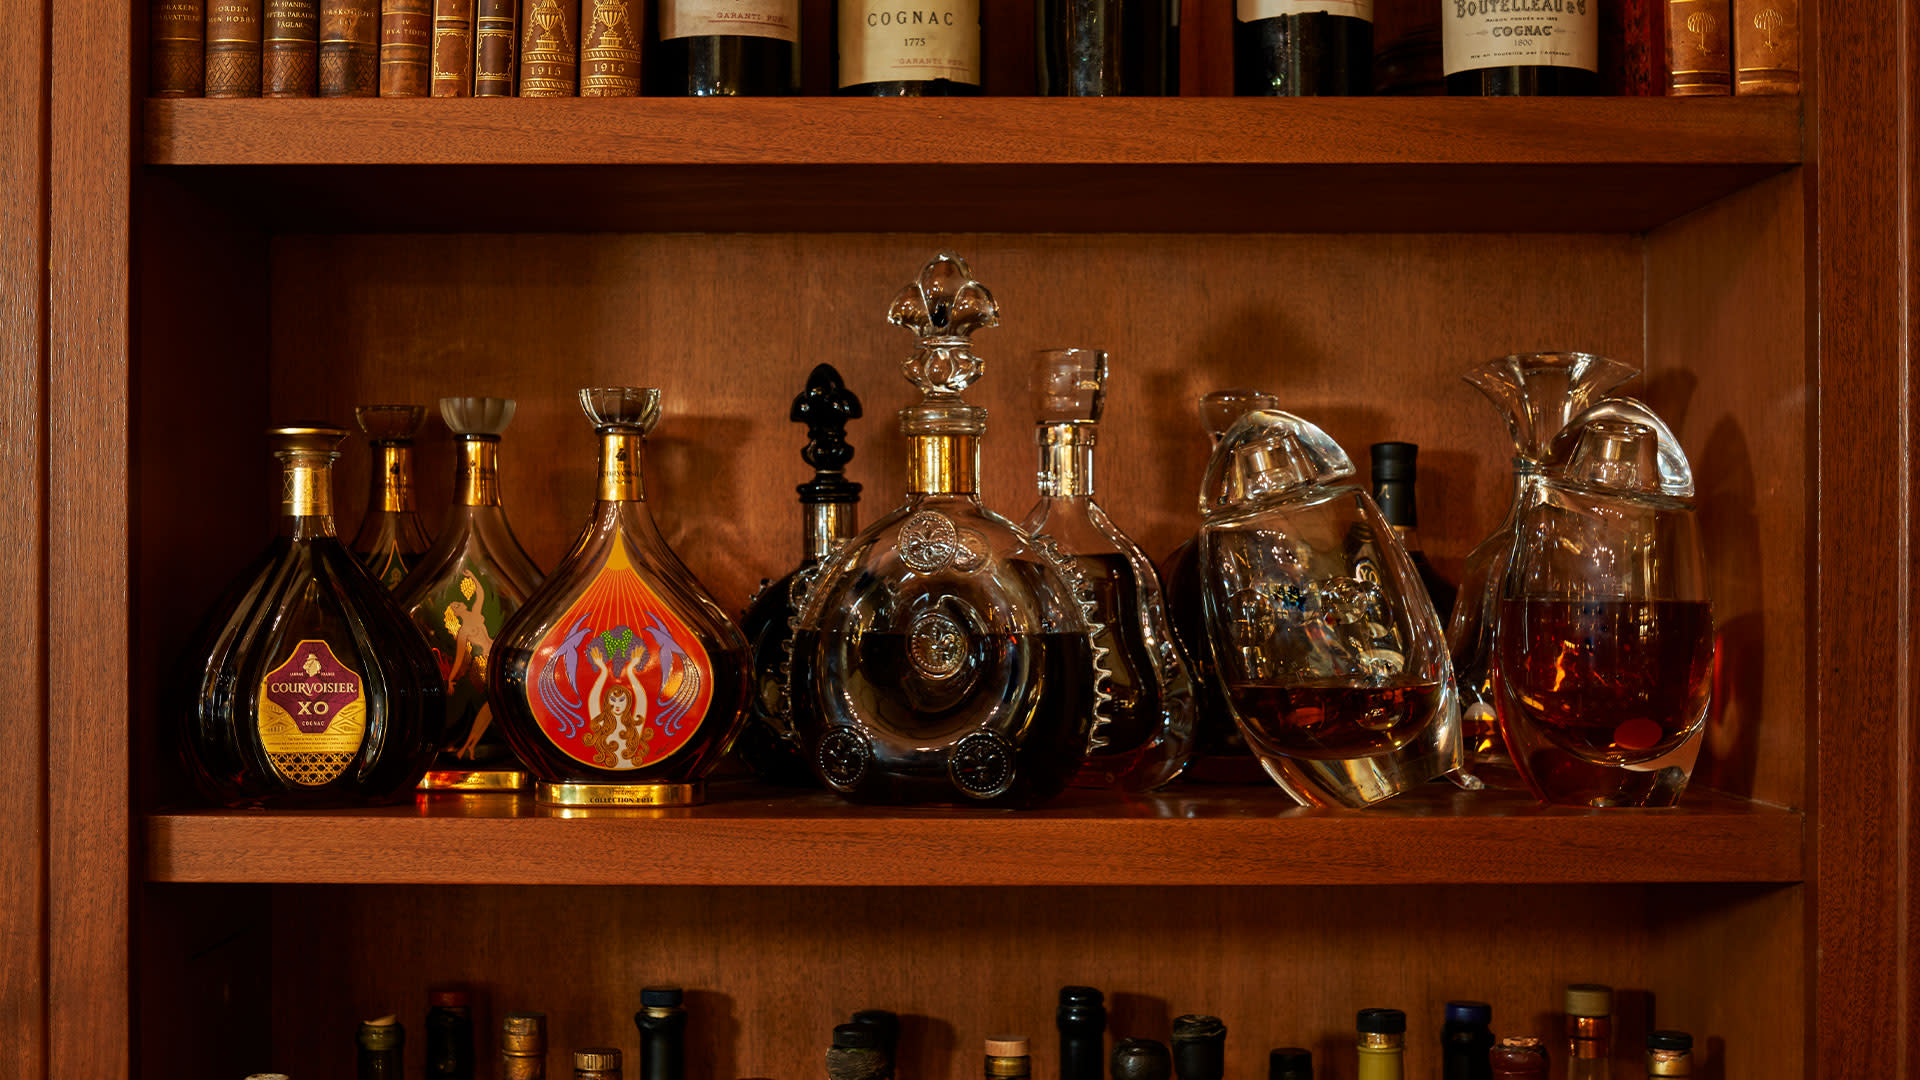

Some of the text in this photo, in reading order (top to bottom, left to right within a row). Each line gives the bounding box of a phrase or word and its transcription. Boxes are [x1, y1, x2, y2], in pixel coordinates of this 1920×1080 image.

[867, 10, 954, 26] COGNAC
[1493, 25, 1553, 37] COGNAC
[904, 37, 926, 46] 1775
[1514, 39, 1533, 47] 1800
[530, 66, 561, 76] 1915
[594, 63, 625, 73] 1915
[271, 683, 356, 696] COURVOISIER
[298, 701, 329, 715] XO
